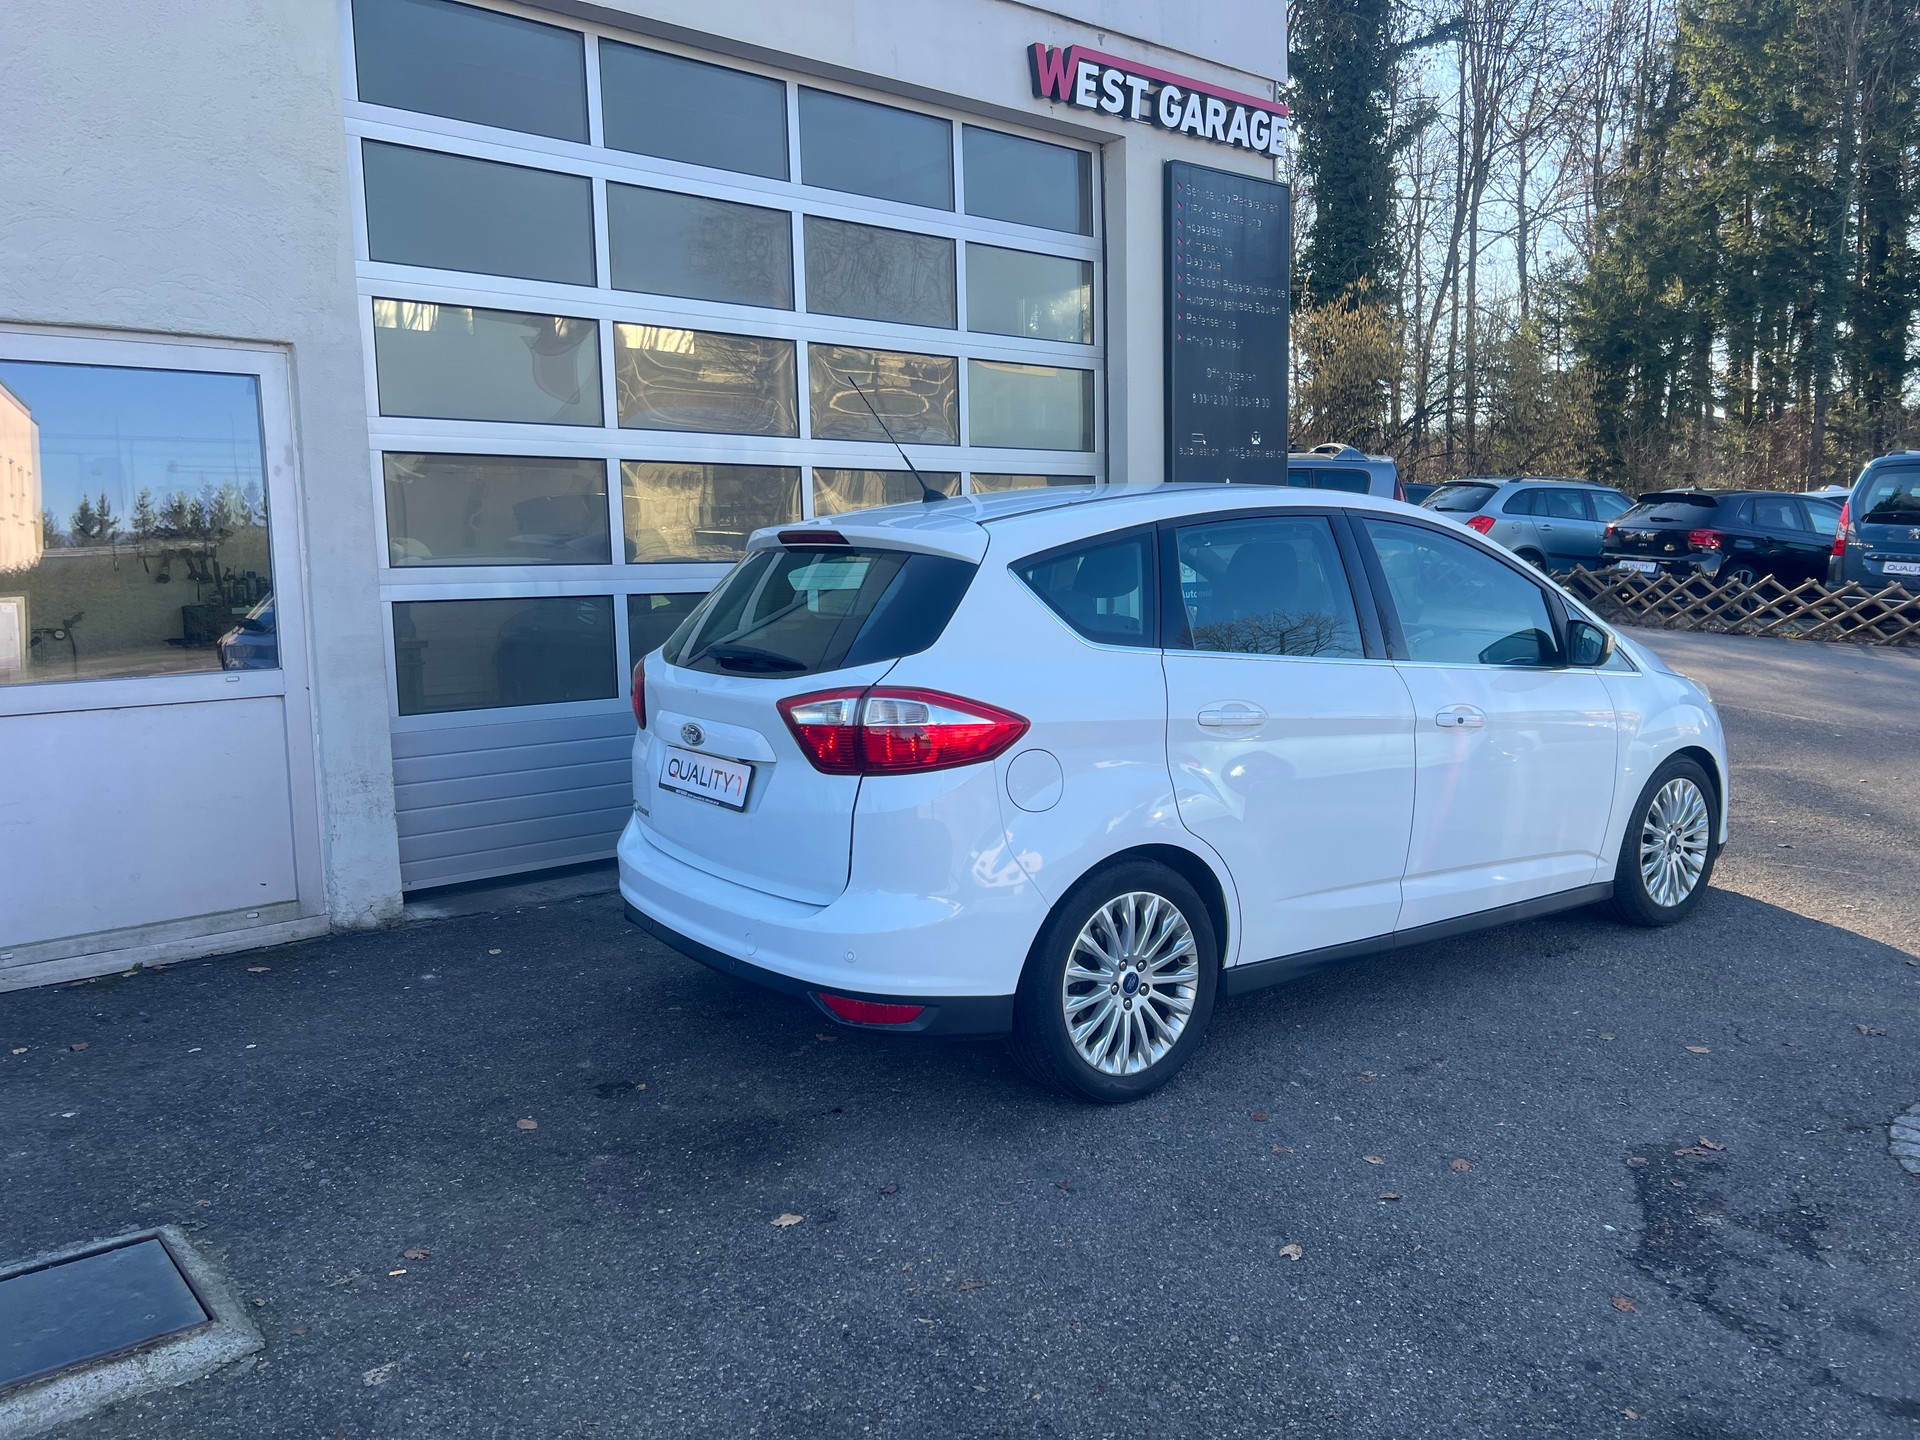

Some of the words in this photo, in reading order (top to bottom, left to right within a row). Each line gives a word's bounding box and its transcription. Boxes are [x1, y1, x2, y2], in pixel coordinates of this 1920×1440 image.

[1029, 42, 1150, 120] WEST
[1157, 85, 1289, 157] GARAGE
[1186, 183, 1215, 200] Serce
[1186, 253, 1222, 270] Dagnose
